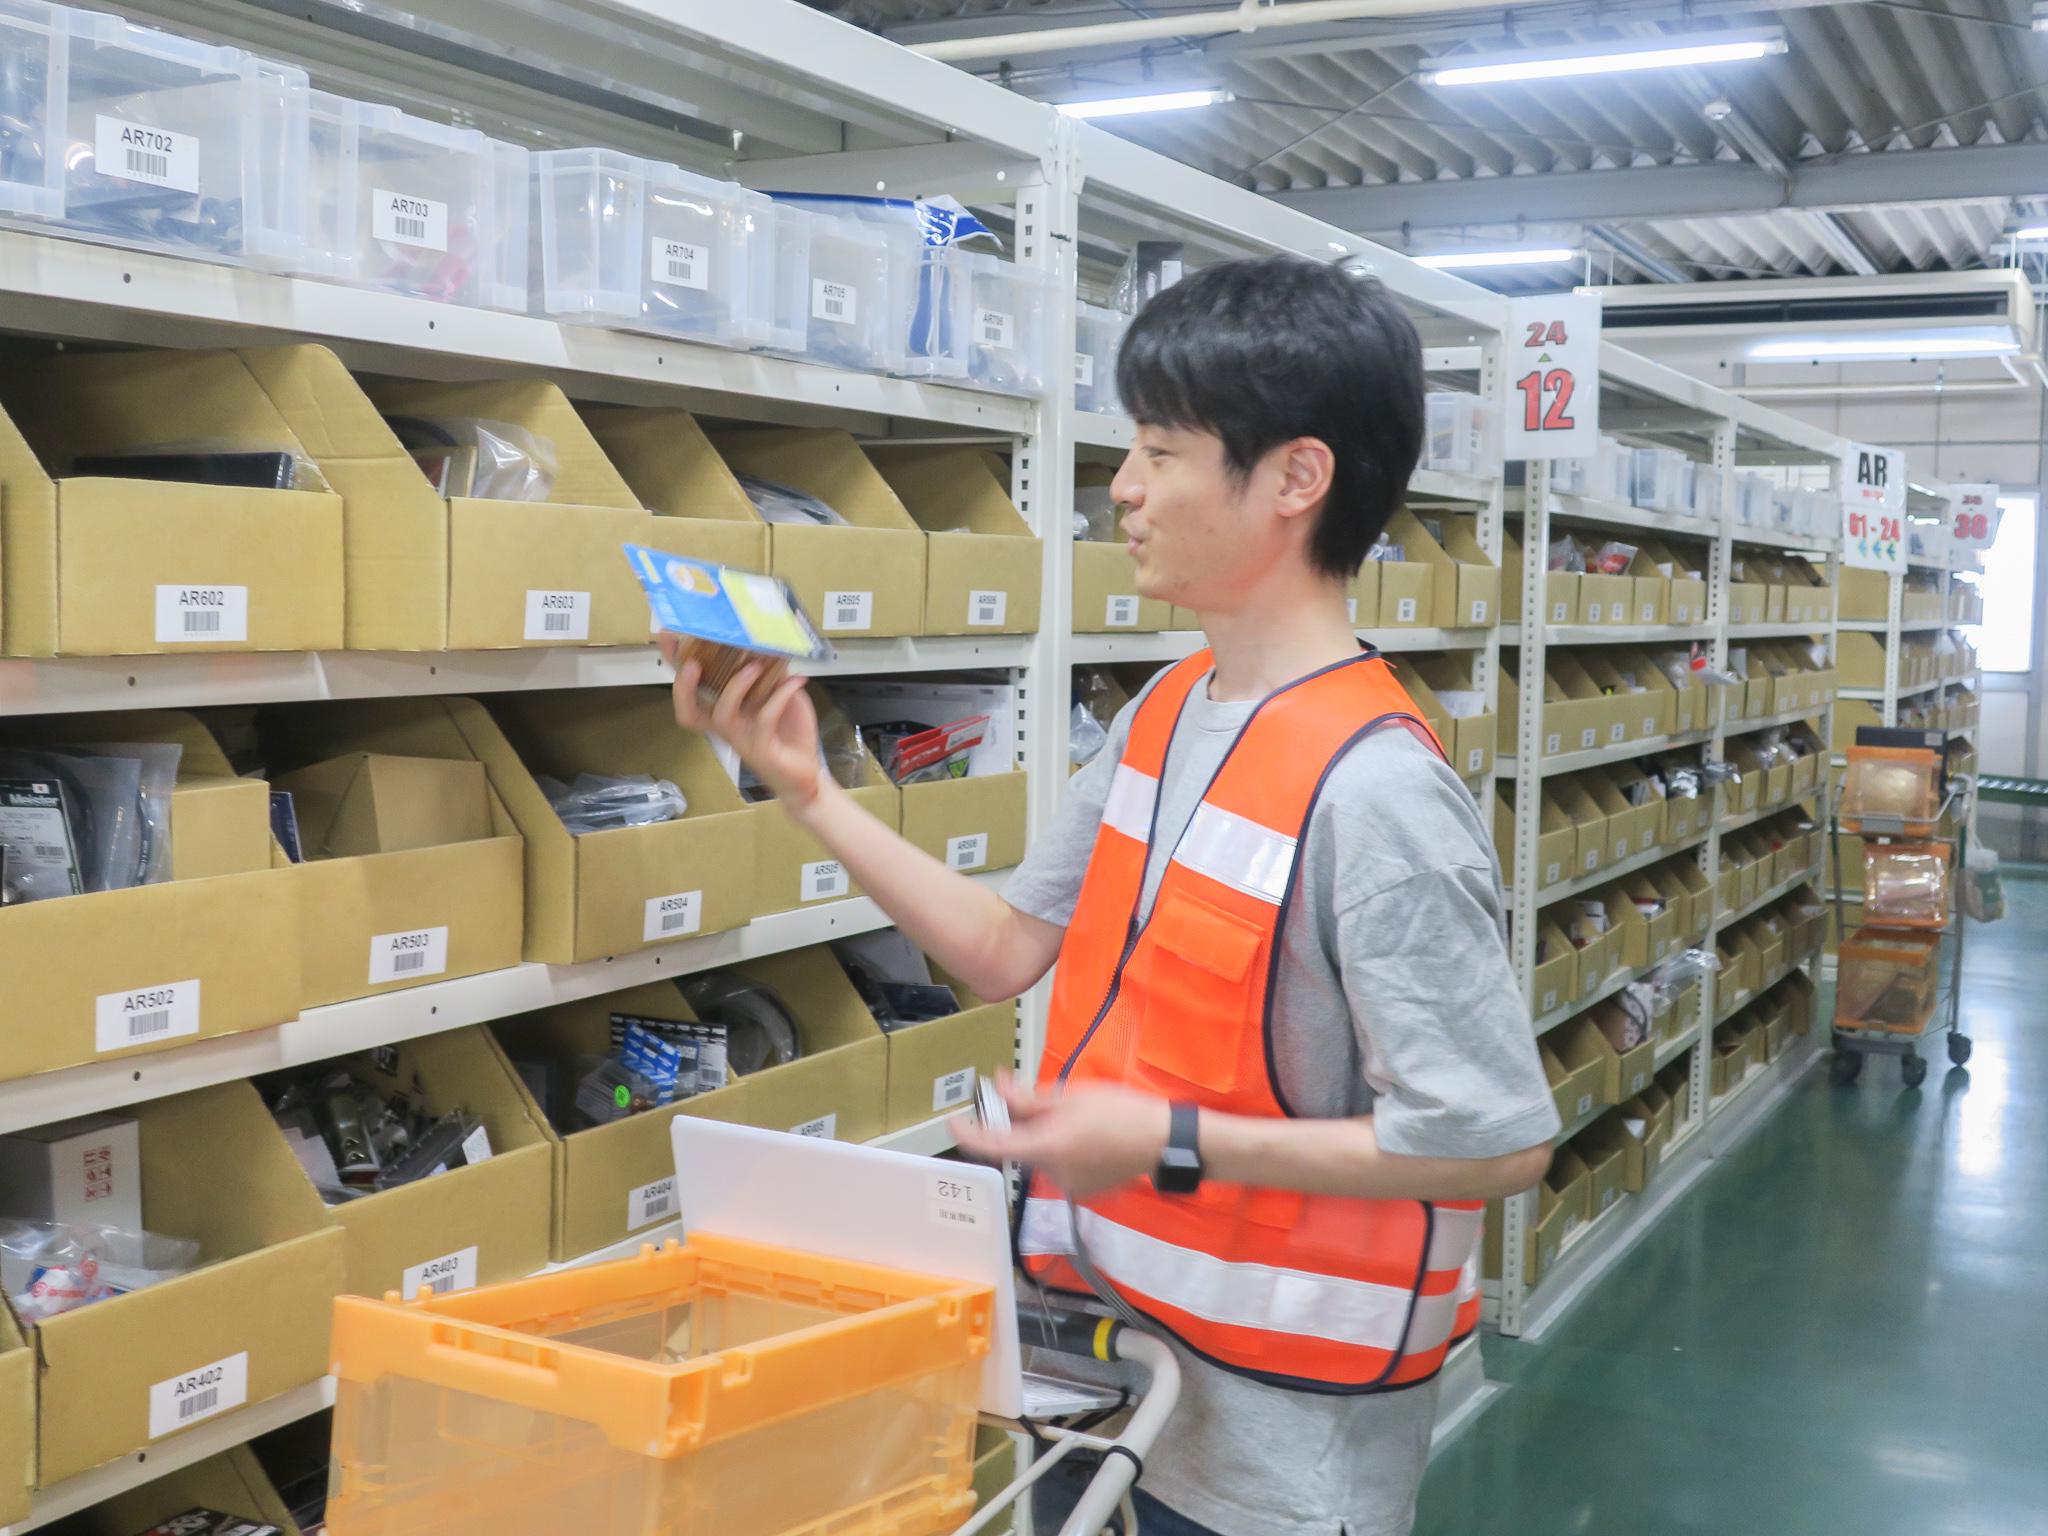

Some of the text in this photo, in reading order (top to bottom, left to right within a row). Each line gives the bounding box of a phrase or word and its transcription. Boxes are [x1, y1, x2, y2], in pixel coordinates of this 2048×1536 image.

[120, 127, 172, 152] AR702
[391, 197, 428, 217] AR703
[665, 244, 694, 260] AR704
[1524, 320, 1568, 347] 24
[1516, 368, 1575, 431] 12
[1857, 452, 1887, 488] AR
[1953, 513, 1988, 540] 30
[179, 590, 224, 606] AR602
[541, 595, 575, 608] AR603
[660, 897, 688, 912] AR504
[390, 934, 429, 951] AR503
[122, 989, 174, 1012] AR502
[643, 1181, 672, 1199] AR404
[937, 1180, 973, 1201] 142
[421, 1257, 458, 1280] AR403
[174, 1366, 223, 1397] AR402
